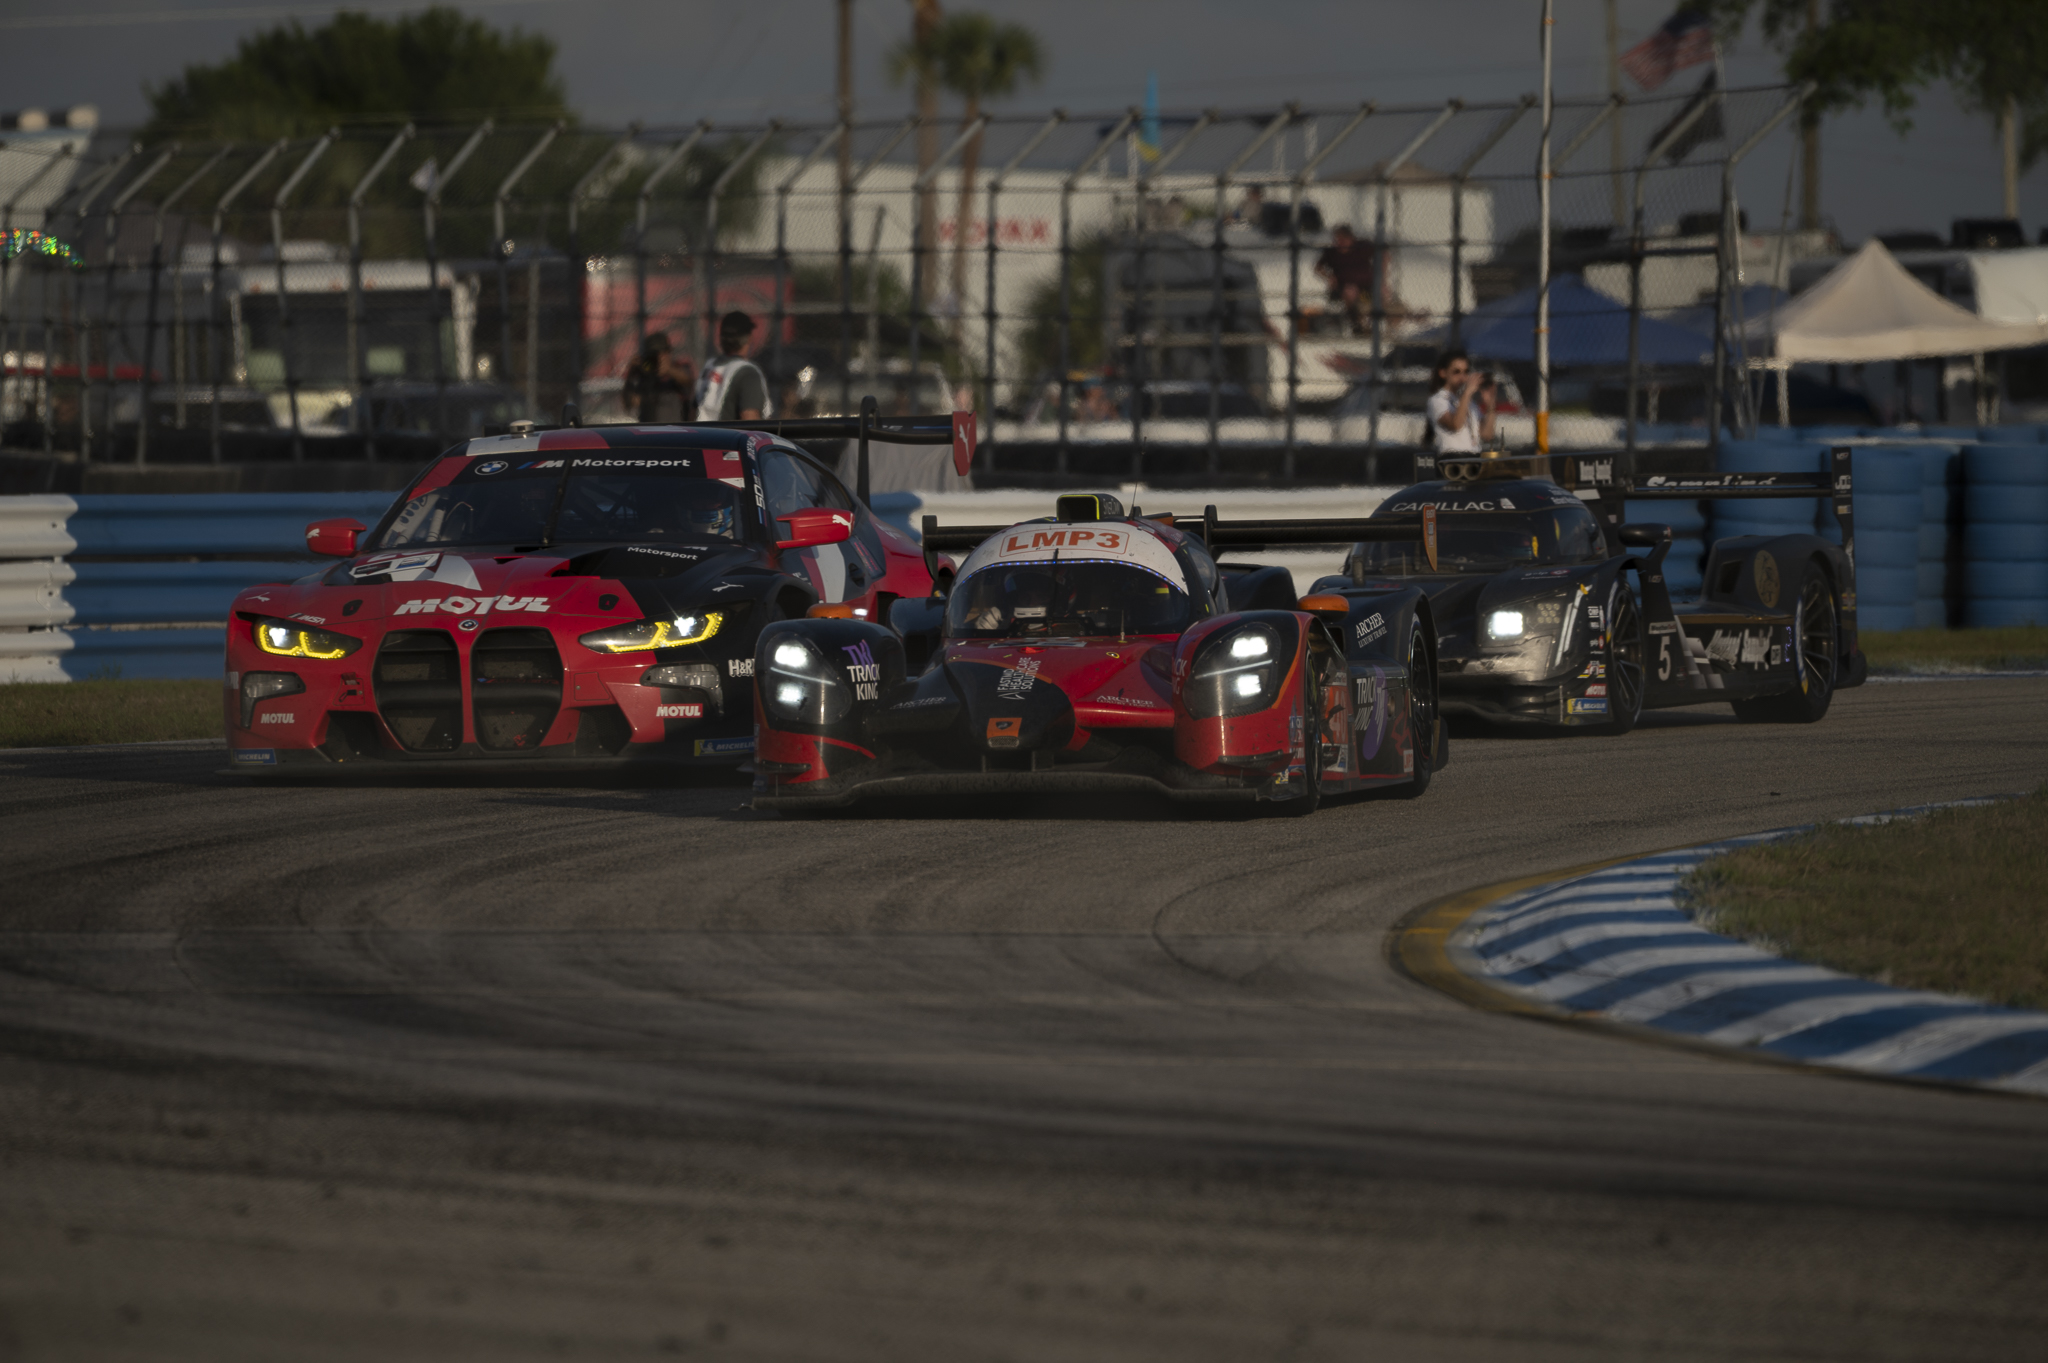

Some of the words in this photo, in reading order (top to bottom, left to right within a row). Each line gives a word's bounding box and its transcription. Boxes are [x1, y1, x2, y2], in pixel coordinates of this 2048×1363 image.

[572, 458, 691, 468] Motorsport
[1006, 530, 1120, 553] LMP3
[627, 546, 698, 561] Motorsport
[393, 595, 551, 615] MOTUL
[1355, 612, 1385, 639] ARCHER
[1657, 635, 1671, 681] 5
[846, 663, 880, 682] TRACK
[1020, 660, 1041, 690] SOLUTIONS
[855, 682, 878, 700] KING
[1096, 695, 1154, 705] ARCHER
[261, 713, 295, 724] MOTUL
[656, 706, 701, 717] MOTUL
